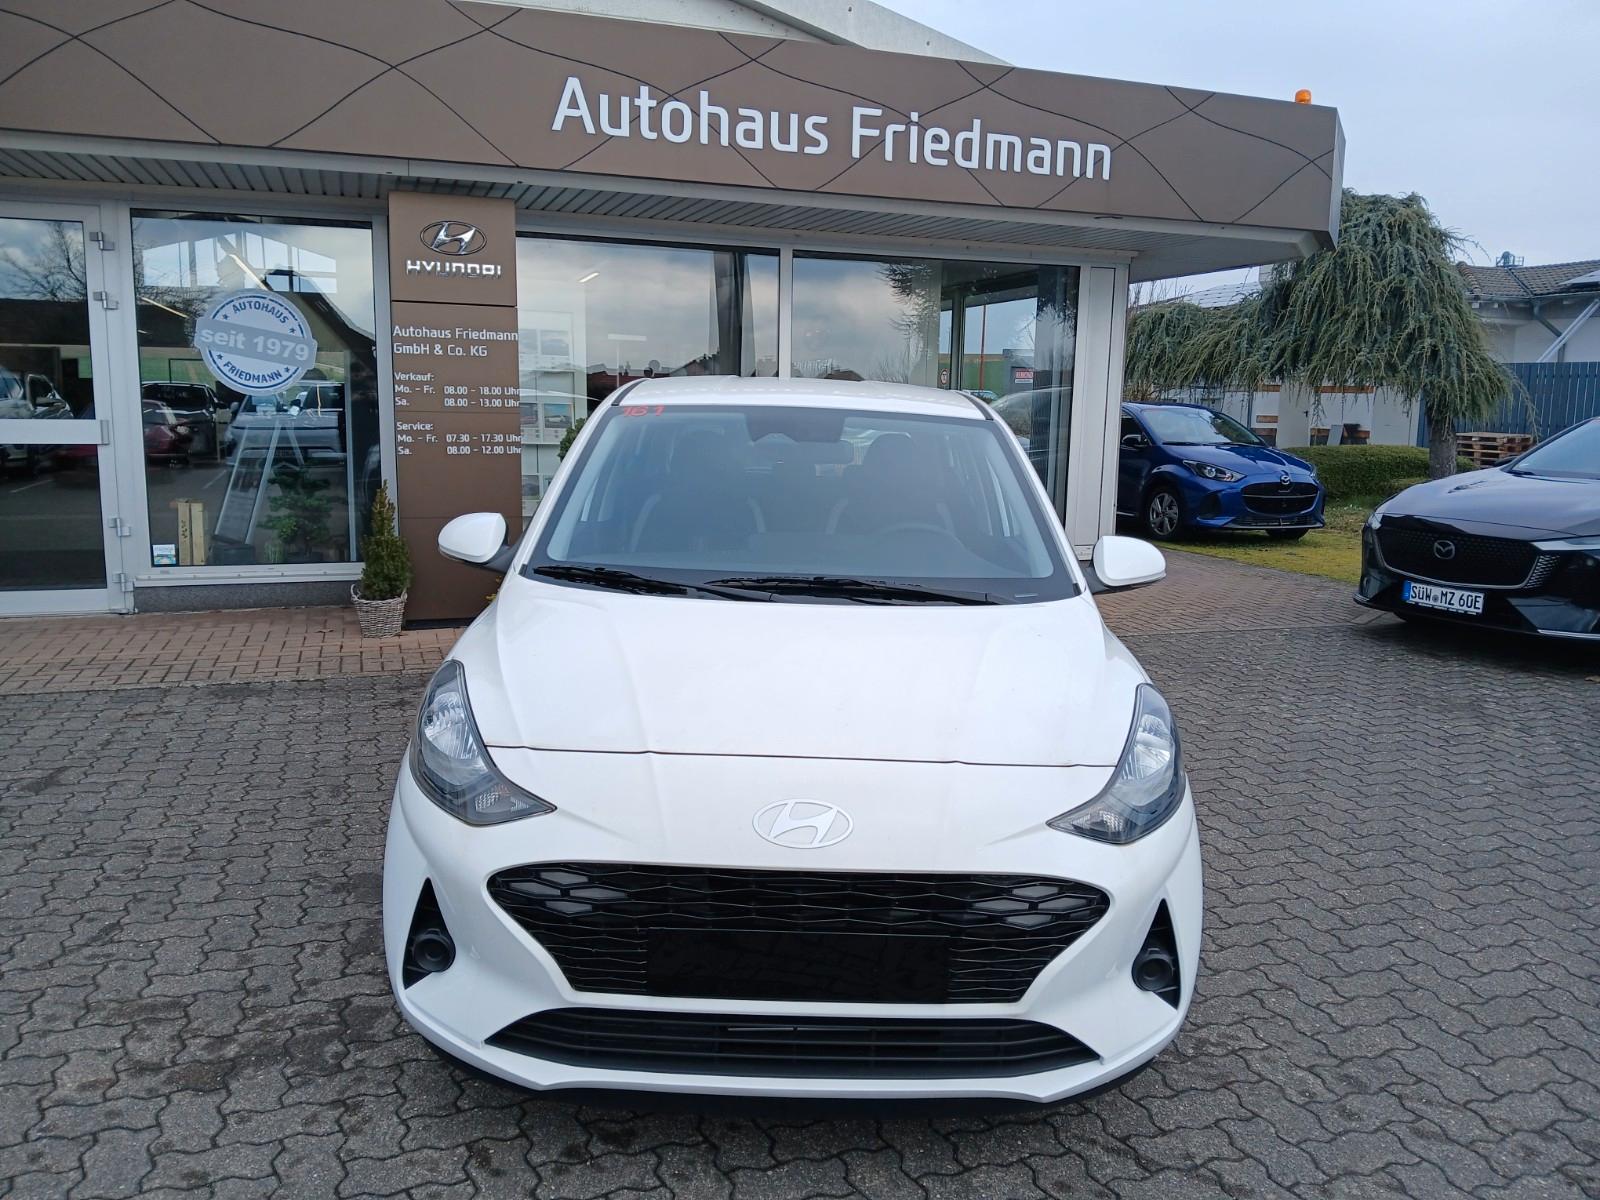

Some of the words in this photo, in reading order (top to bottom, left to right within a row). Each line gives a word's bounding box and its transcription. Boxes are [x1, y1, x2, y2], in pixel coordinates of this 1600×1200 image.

[551, 76, 829, 155] Autohaus
[851, 106, 1112, 181] Friedmann
[406, 260, 502, 278] HYUNDAI
[232, 300, 290, 324] AUTOHAUS
[392, 325, 452, 339] Autohaus
[455, 328, 519, 341] Friedmann
[201, 329, 246, 350] seit
[253, 335, 310, 361] 1979
[393, 342, 430, 355] GmbH
[434, 344, 443, 355] &
[447, 344, 467, 356] Co.
[470, 345, 488, 357] KG
[223, 361, 283, 384] FRIEDMANN
[394, 371, 435, 381] Verkauf:
[395, 384, 412, 393] Mo.
[423, 385, 436, 394] Fr.
[444, 385, 468, 395] 08.00
[479, 386, 502, 395] 18.00
[504, 386, 520, 395] Uhr
[395, 396, 410, 406] Sa.
[444, 398, 468, 407] 08.00
[479, 398, 502, 408] 13.00
[504, 398, 520, 408] Uhr
[396, 421, 434, 431] Service:
[397, 433, 415, 443] Mo.
[426, 433, 438, 443] Fr.
[446, 433, 470, 443] 07.30
[480, 433, 504, 443] 17.30
[506, 433, 523, 443] Uhr
[398, 446, 412, 455] Sa.
[446, 445, 471, 455] 08.00
[481, 445, 505, 455] 12.00
[507, 445, 522, 455] Uhr
[1411, 585, 1432, 602] SÜW
[1440, 590, 1455, 606] MZ
[1458, 593, 1482, 610] 60E
